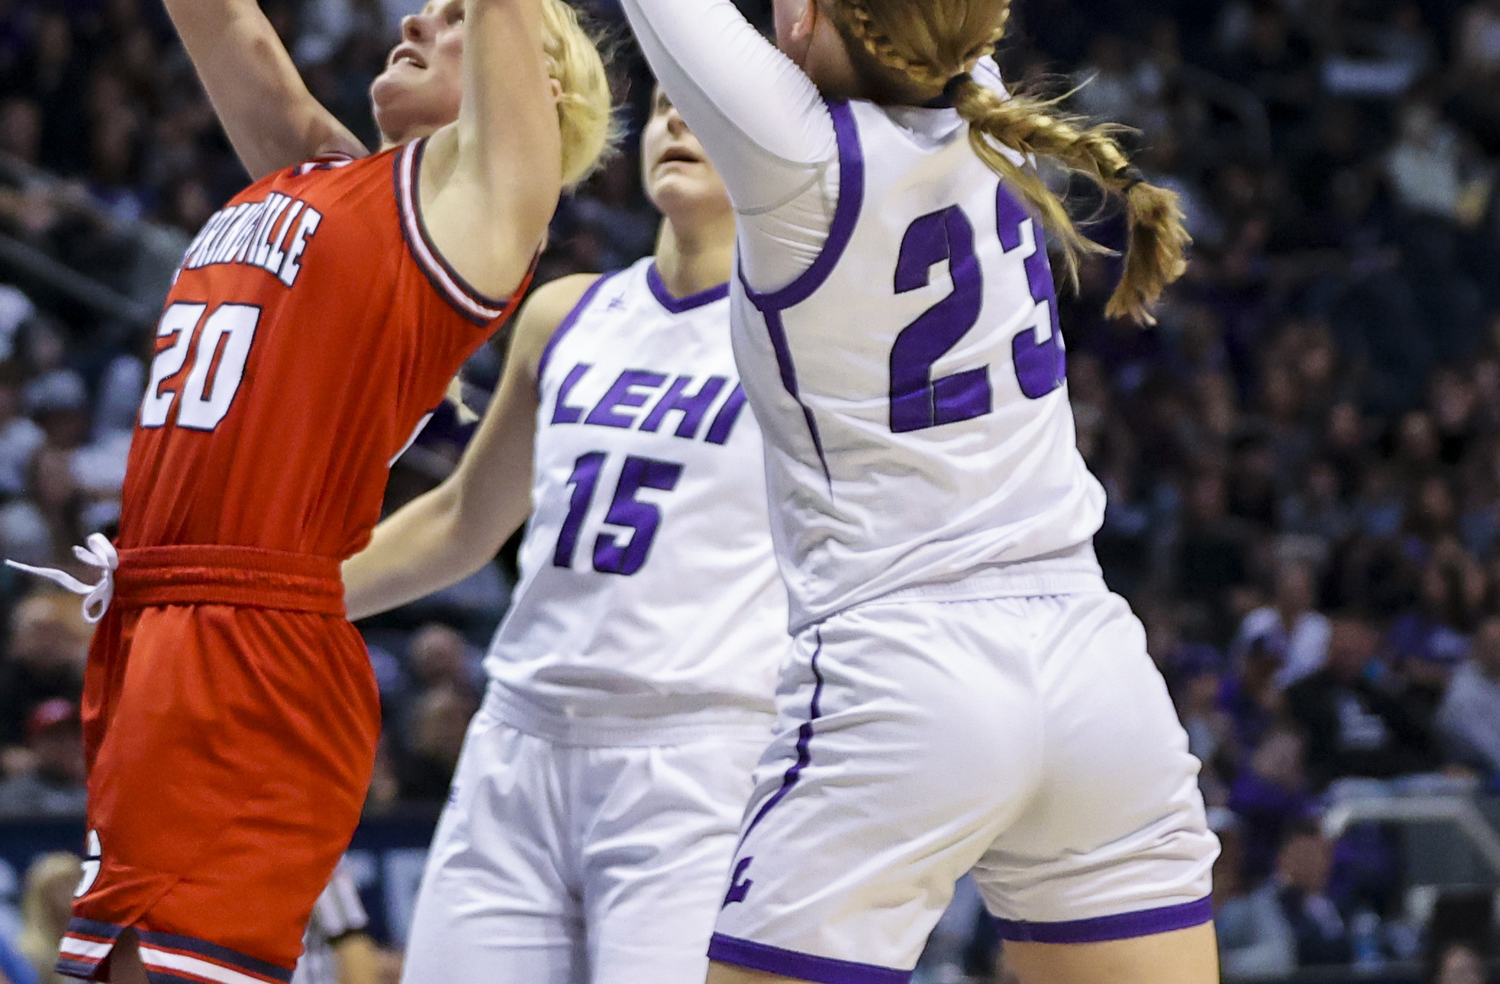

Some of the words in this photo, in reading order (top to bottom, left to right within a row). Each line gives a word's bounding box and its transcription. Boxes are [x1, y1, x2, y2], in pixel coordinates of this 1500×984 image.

[171, 190, 323, 289] PRINGVILLE
[140, 300, 263, 433] 20
[890, 178, 1067, 434] 23
[550, 362, 748, 446] LEHI
[553, 450, 687, 577] 15
